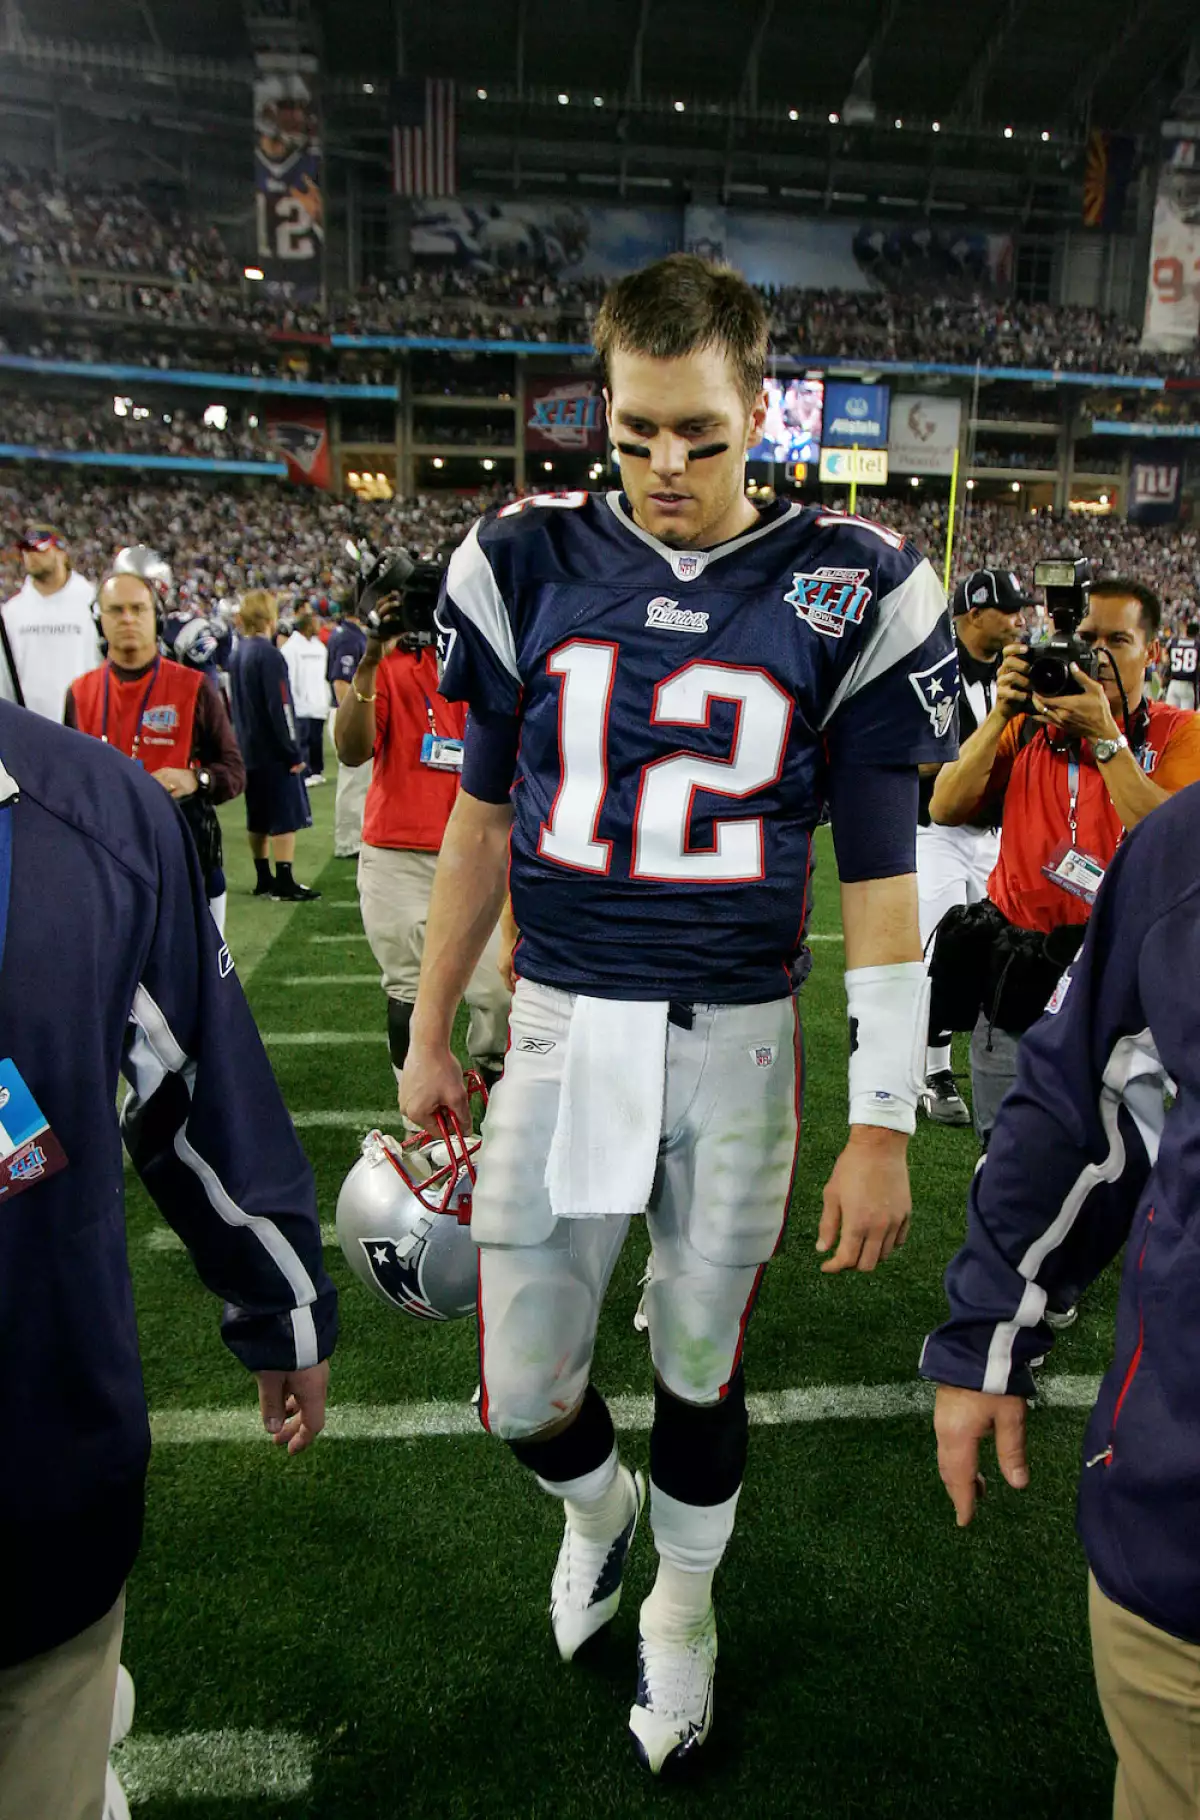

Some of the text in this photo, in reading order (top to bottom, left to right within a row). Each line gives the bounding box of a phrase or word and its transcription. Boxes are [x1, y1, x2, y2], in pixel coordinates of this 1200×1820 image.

[256, 193, 315, 259] 12
[820, 570, 858, 579] SUPER
[785, 578, 867, 622] XLII
[646, 605, 709, 632] Patriots
[808, 607, 835, 623] BOWL
[1170, 648, 1198, 673] 58
[537, 637, 795, 884] 12
